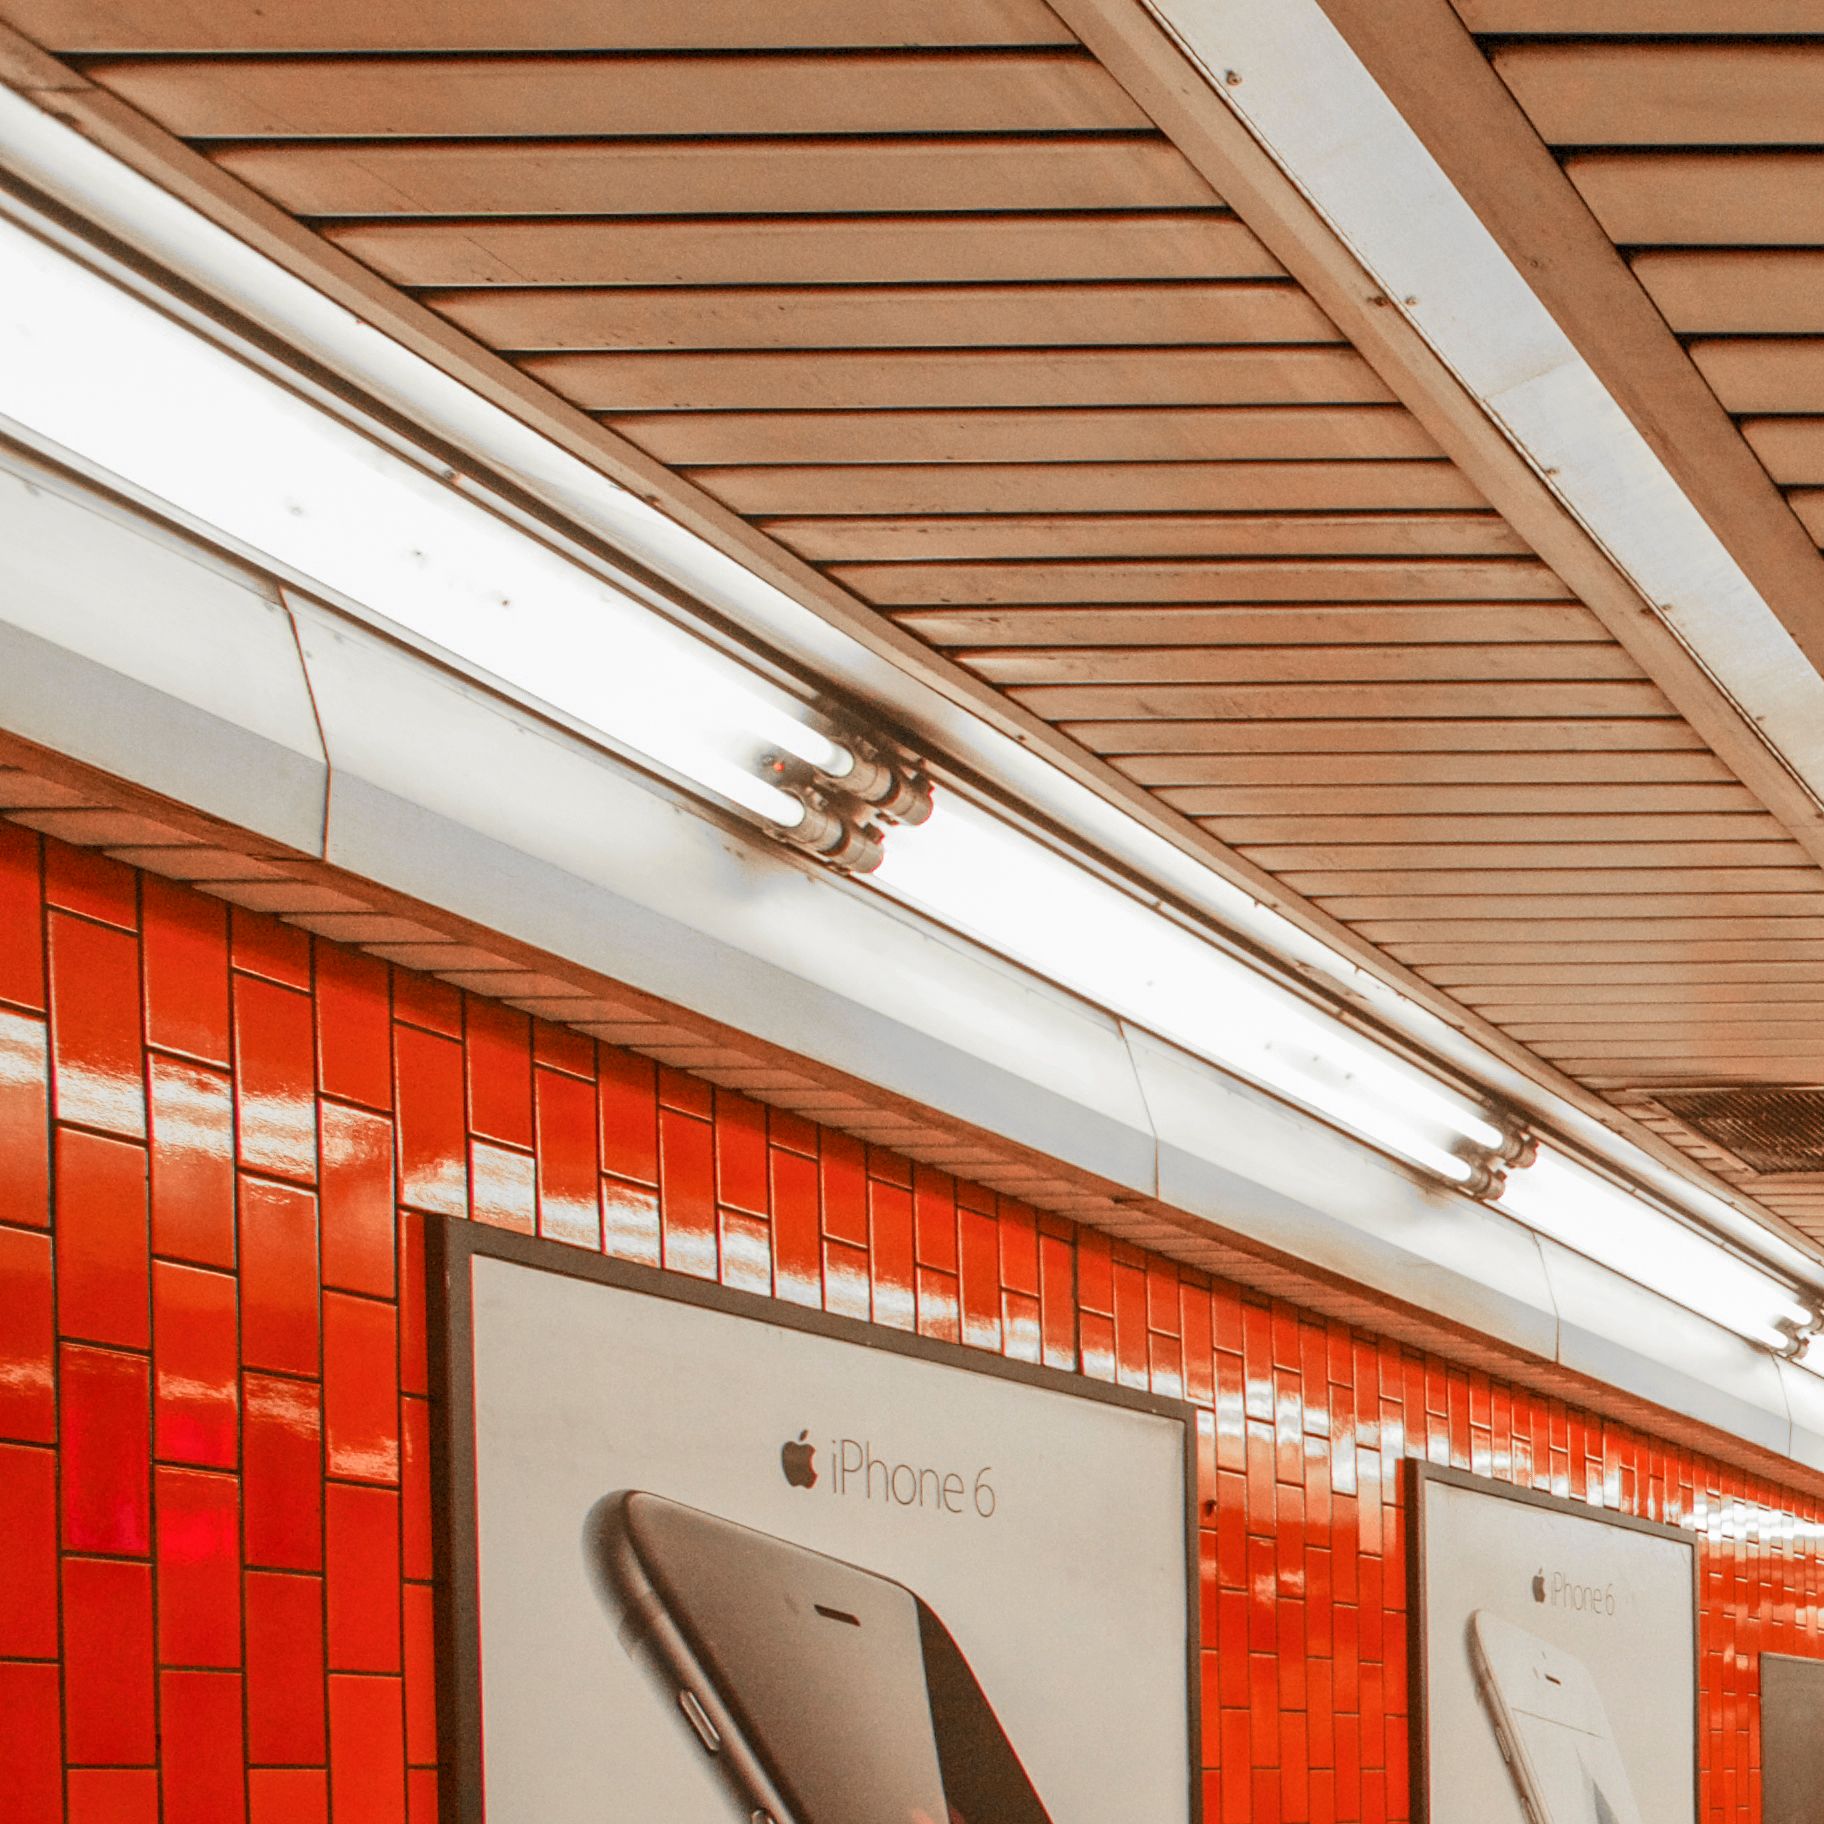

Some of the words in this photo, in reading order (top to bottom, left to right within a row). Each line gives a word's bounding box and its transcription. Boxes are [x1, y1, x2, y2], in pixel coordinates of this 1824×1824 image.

[831, 1439, 965, 1513] iPhone
[974, 1466, 996, 1518] 6
[1551, 1571, 1602, 1614] iPhone
[1605, 1583, 1616, 1615] 6
